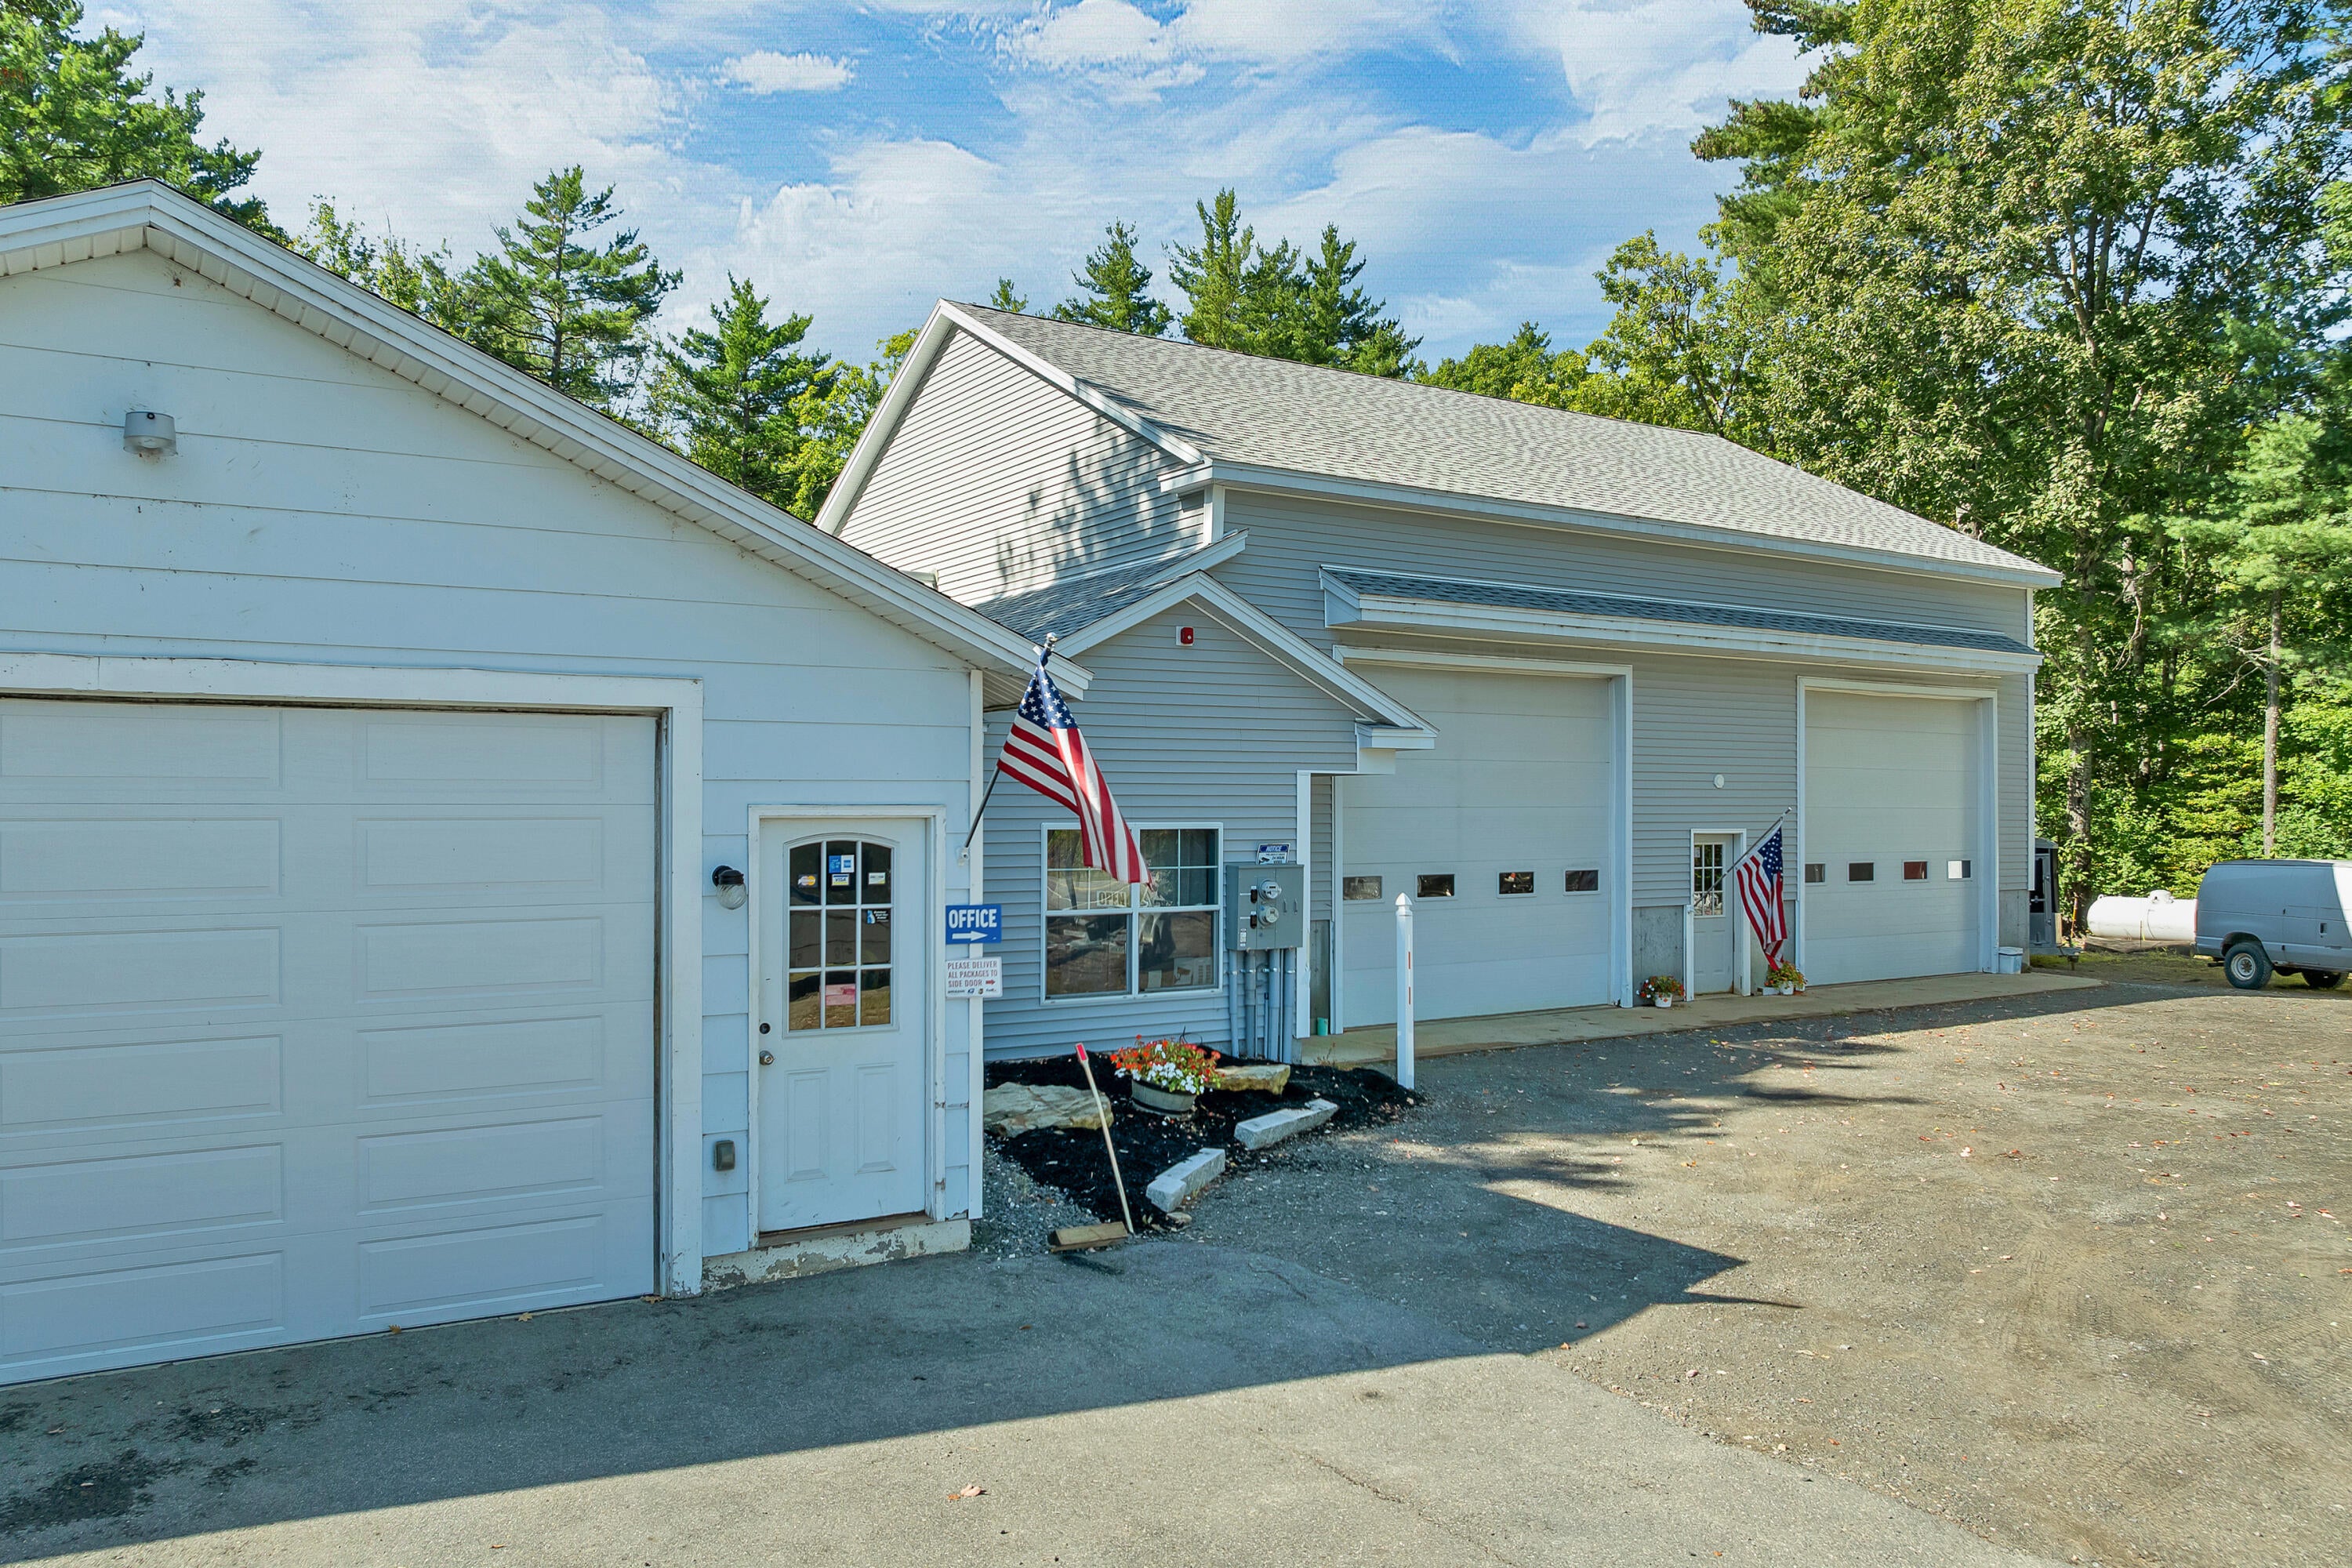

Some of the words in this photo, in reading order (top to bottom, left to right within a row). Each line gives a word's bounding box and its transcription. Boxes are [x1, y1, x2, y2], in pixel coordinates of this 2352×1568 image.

[948, 909, 997, 929] OFFICE
[947, 961, 970, 970] PLEASE
[972, 960, 997, 969] DELIVER
[948, 971, 958, 979] ALL
[960, 970, 989, 978] PACKAGES
